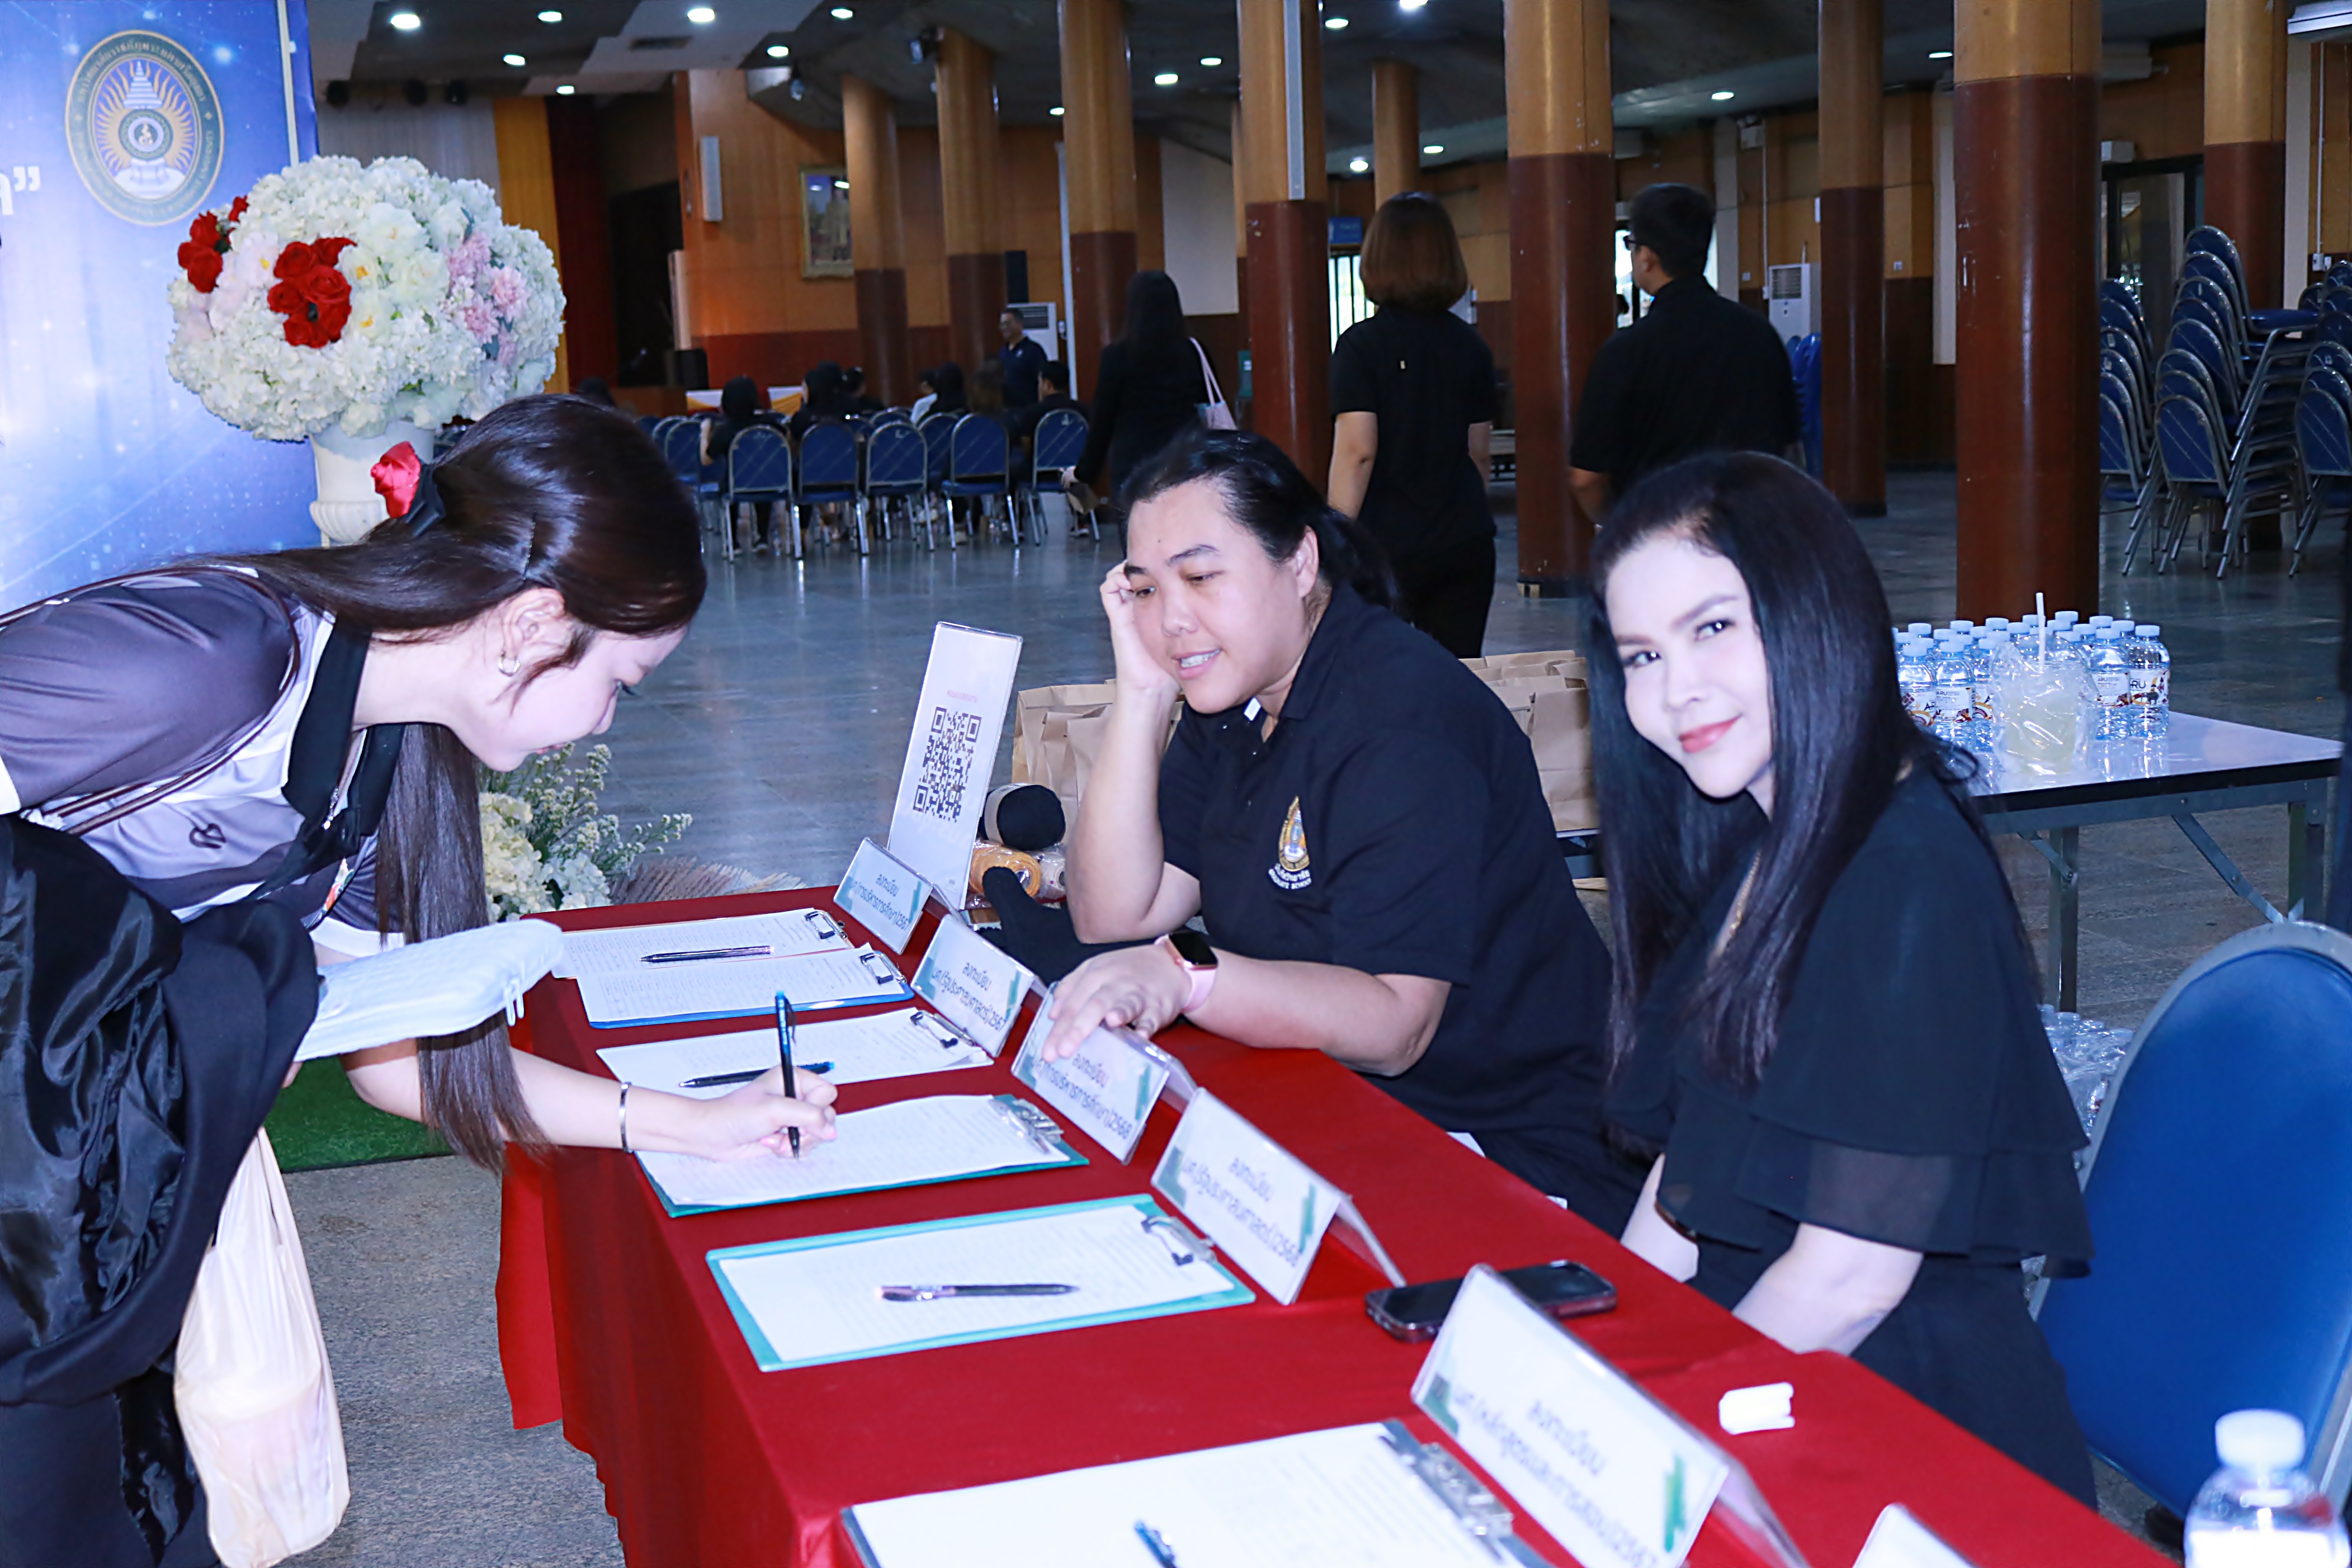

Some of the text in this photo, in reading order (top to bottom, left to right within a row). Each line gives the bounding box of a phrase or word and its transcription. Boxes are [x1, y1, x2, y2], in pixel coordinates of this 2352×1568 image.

[876, 874, 899, 897] ลงทะเบียน
[962, 962, 992, 991] ลงทะเบียน
[1072, 1054, 1109, 1087] ลงทะเบียน
[1229, 1157, 1276, 1202] ลงทะเบียน
[1526, 1397, 1608, 1475] ลงทะเบียน
